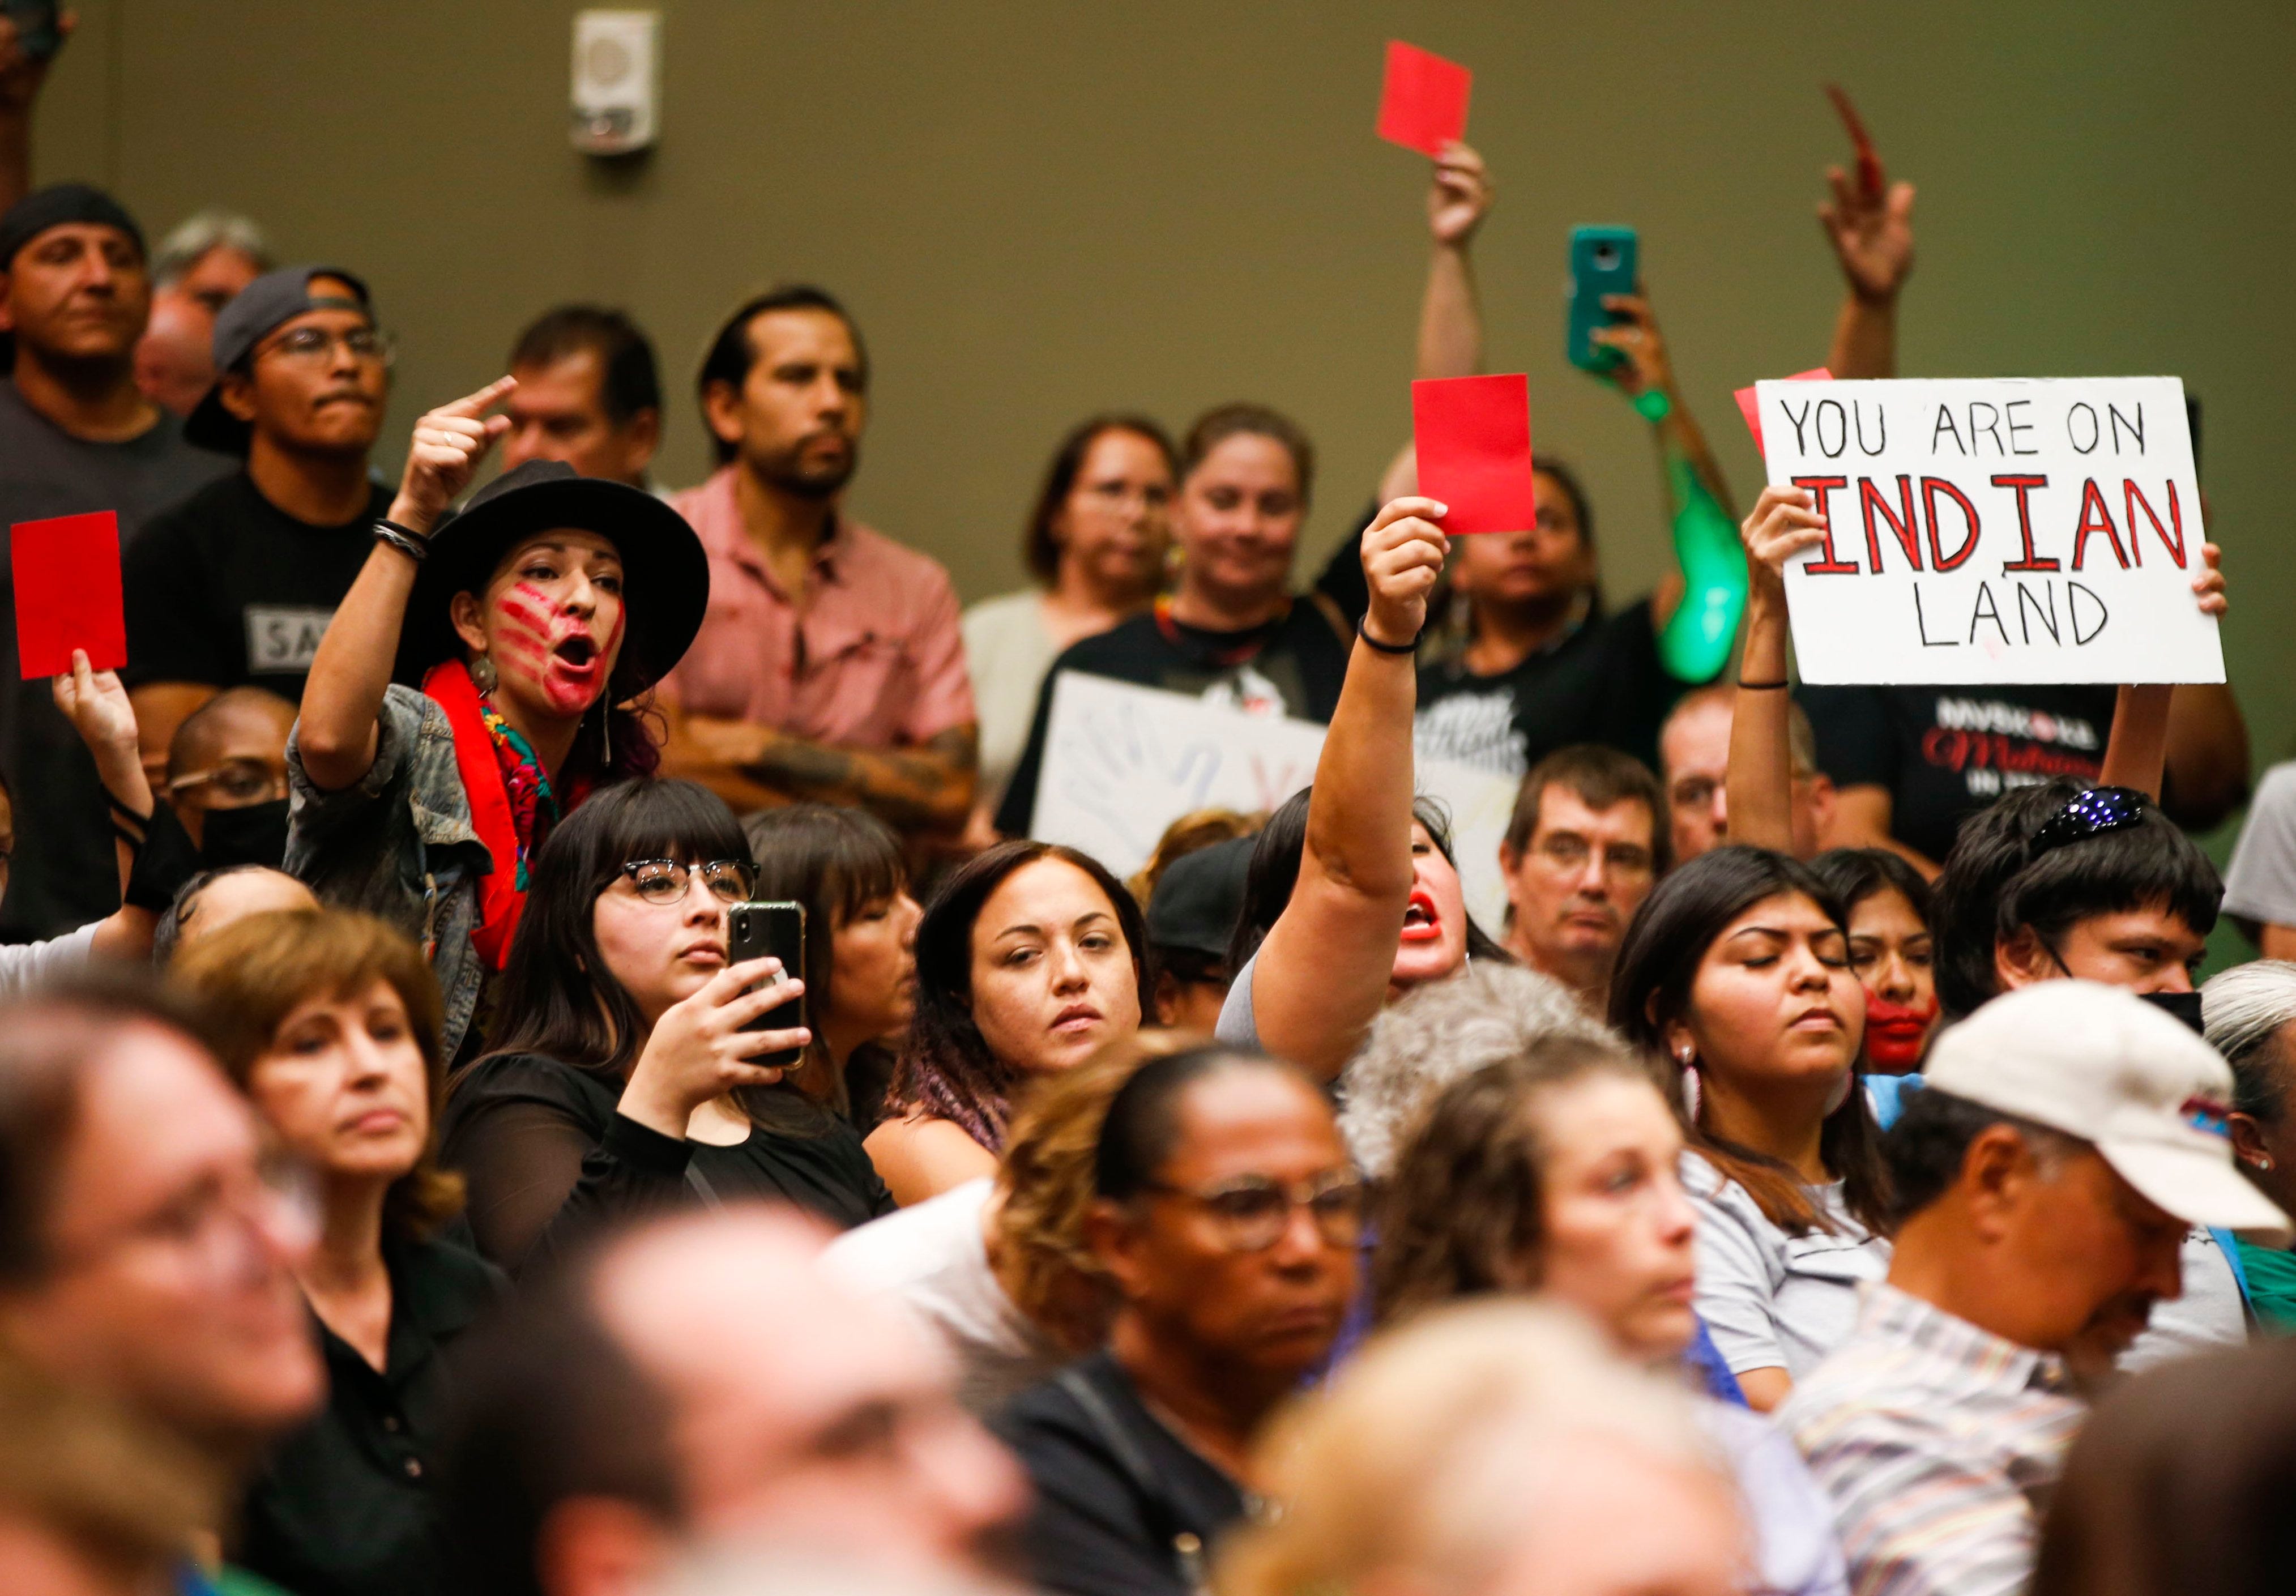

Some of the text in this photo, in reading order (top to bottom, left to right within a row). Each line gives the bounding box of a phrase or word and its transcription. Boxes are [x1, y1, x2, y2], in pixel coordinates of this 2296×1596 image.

[1780, 399, 2144, 459] YOU ARE ON
[1790, 474, 2187, 576] INDIAN
[267, 620, 328, 659] SA
[1914, 581, 2108, 647] LAND
